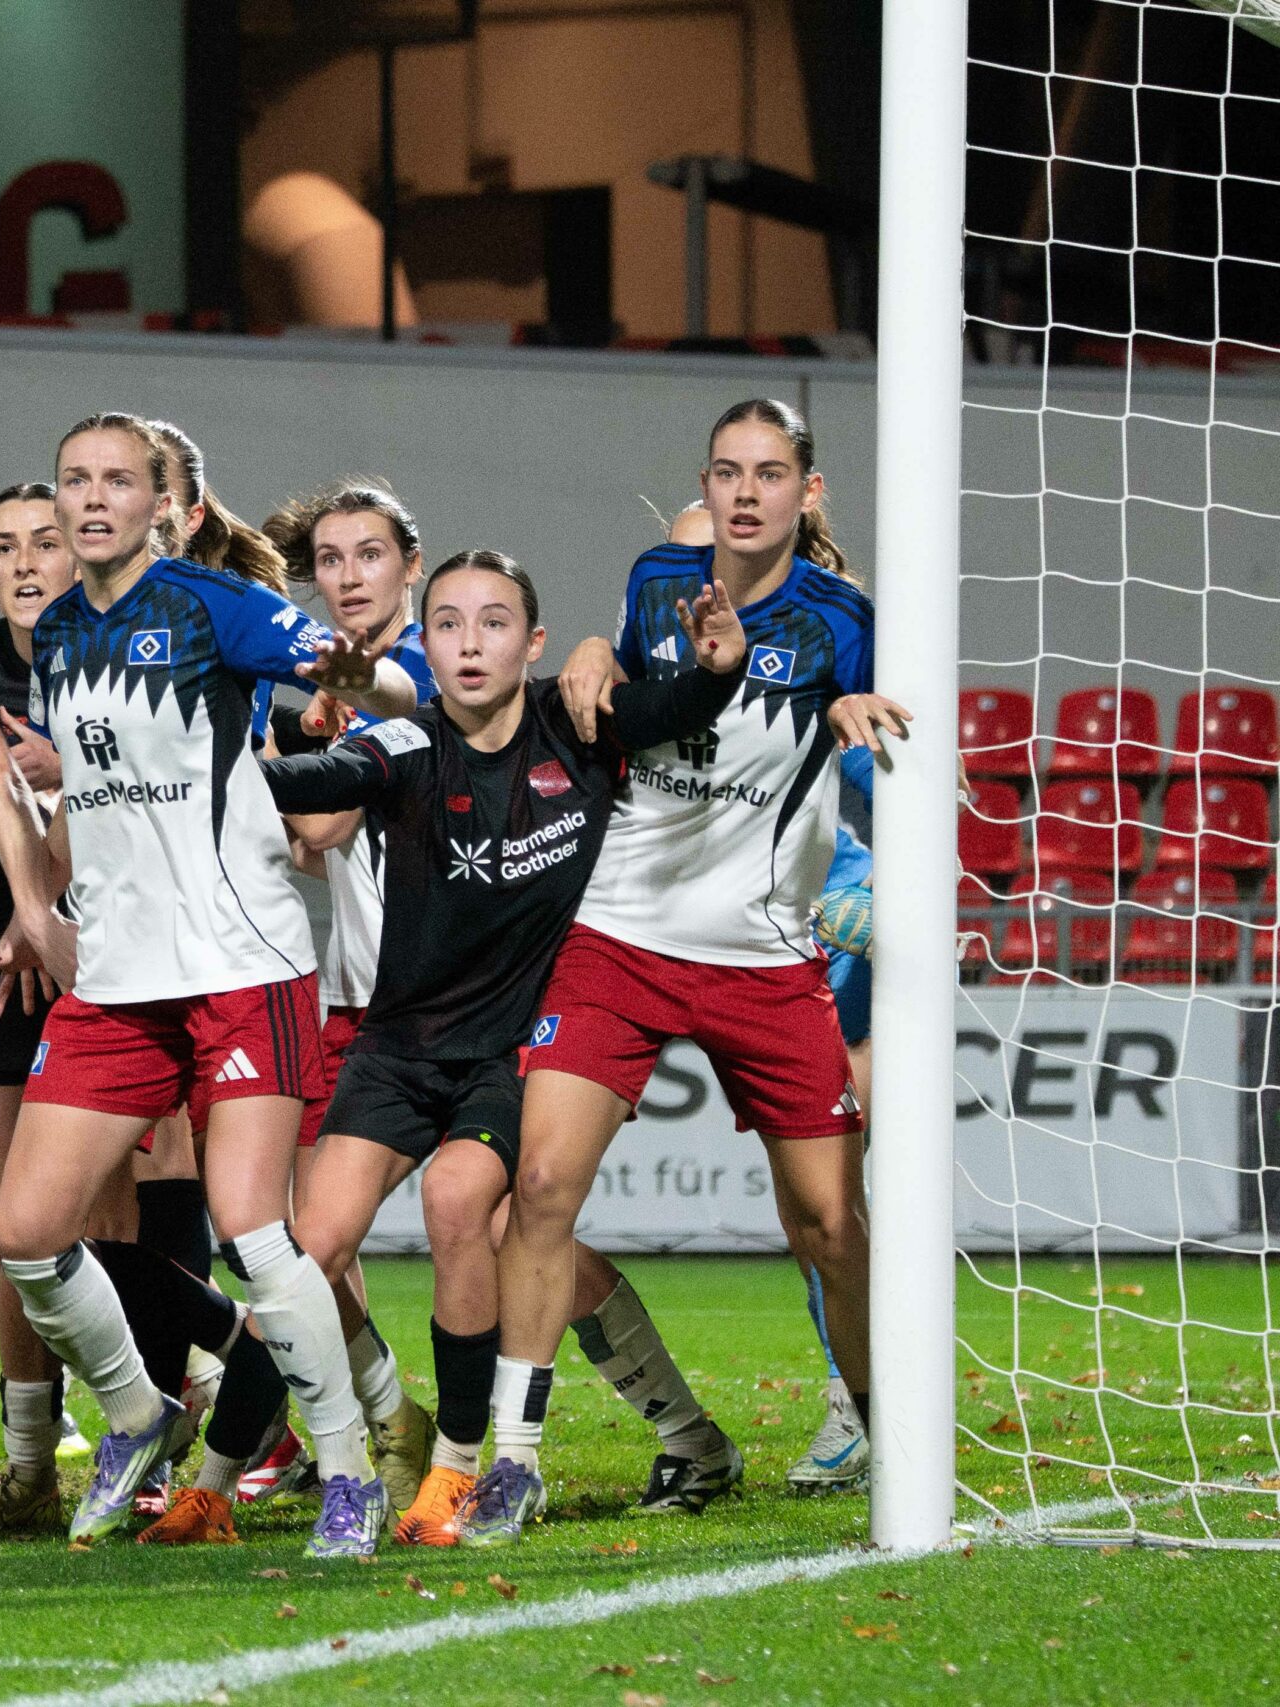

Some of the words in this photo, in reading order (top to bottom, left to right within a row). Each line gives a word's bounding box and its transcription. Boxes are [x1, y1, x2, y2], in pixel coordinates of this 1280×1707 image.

[502, 811, 587, 858] Barmenia
[501, 838, 578, 880] Gothaer
[654, 1156, 725, 1197] für
